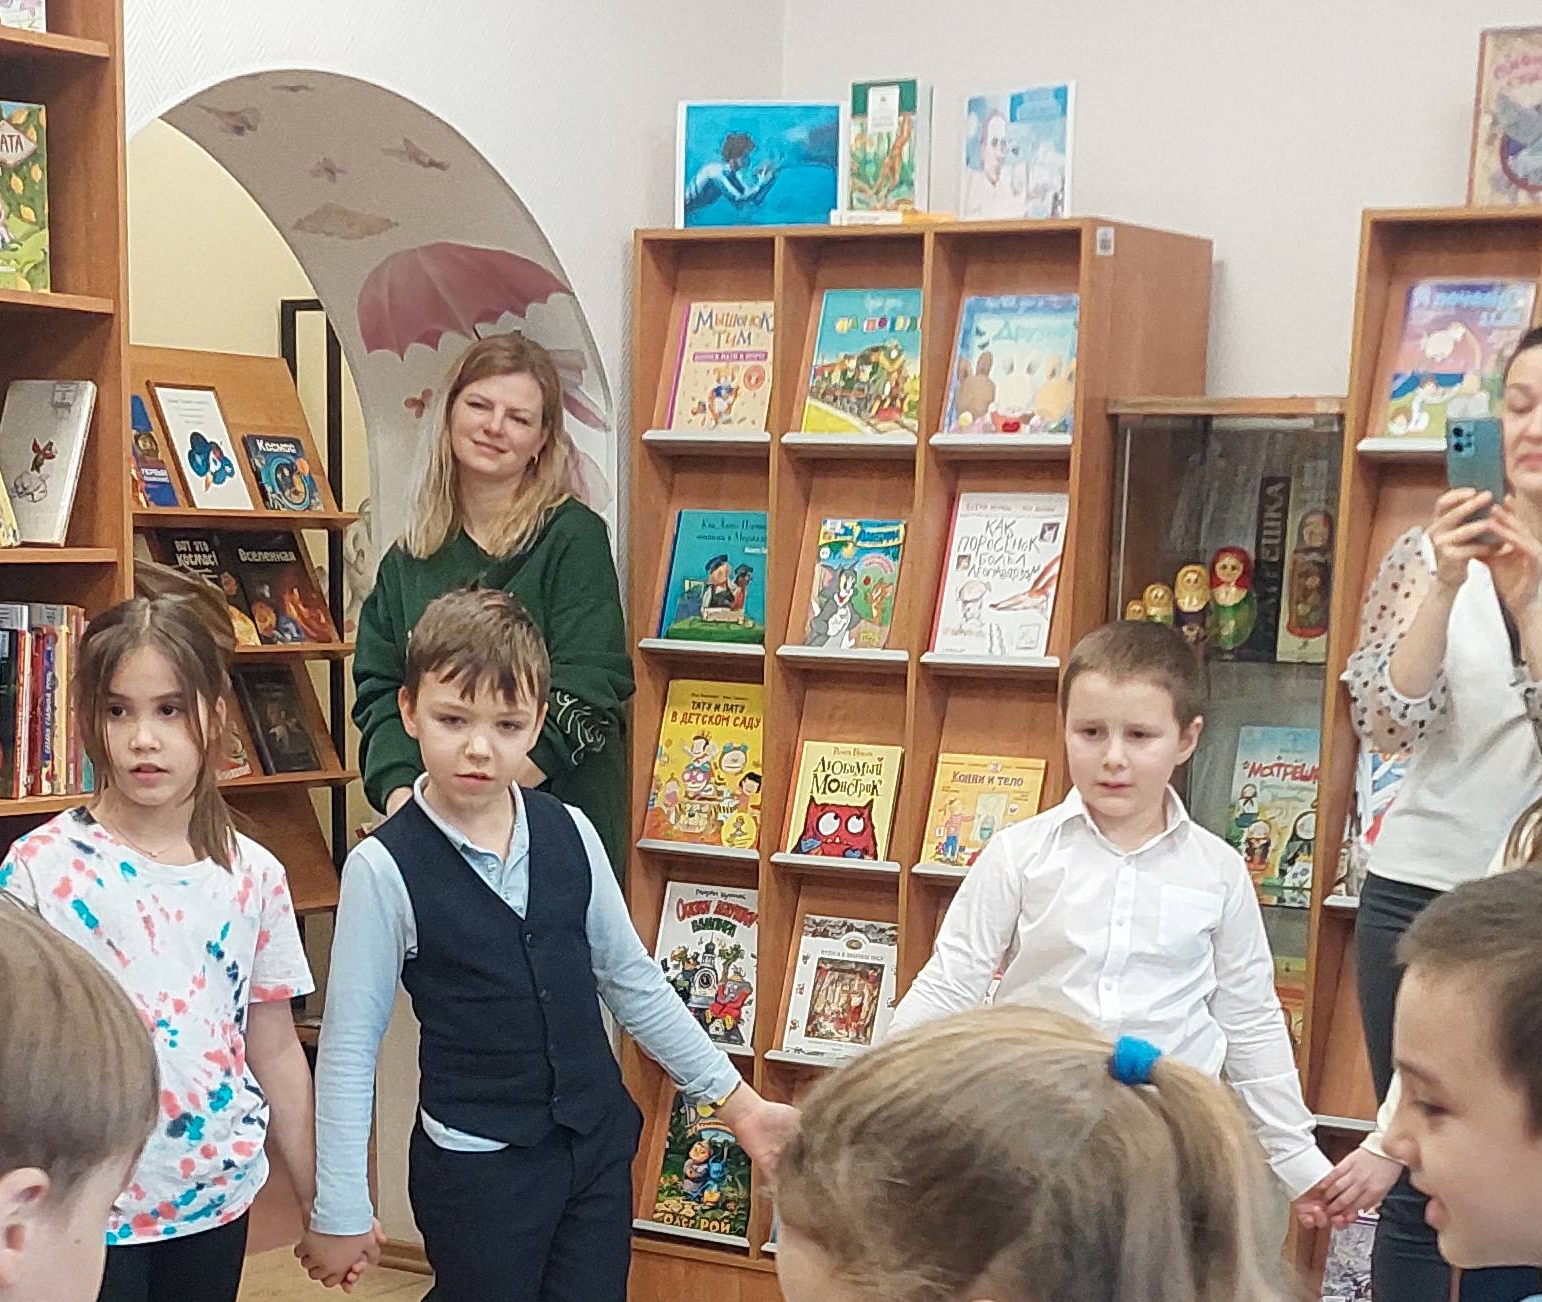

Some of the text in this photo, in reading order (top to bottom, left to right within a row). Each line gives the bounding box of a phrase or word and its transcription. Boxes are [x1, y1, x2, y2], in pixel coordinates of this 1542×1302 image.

[713, 703, 721, 712] И
[670, 711, 762, 731] В ДЕТСКОМ САДУ
[699, 1217, 732, 1234] РОЙ
